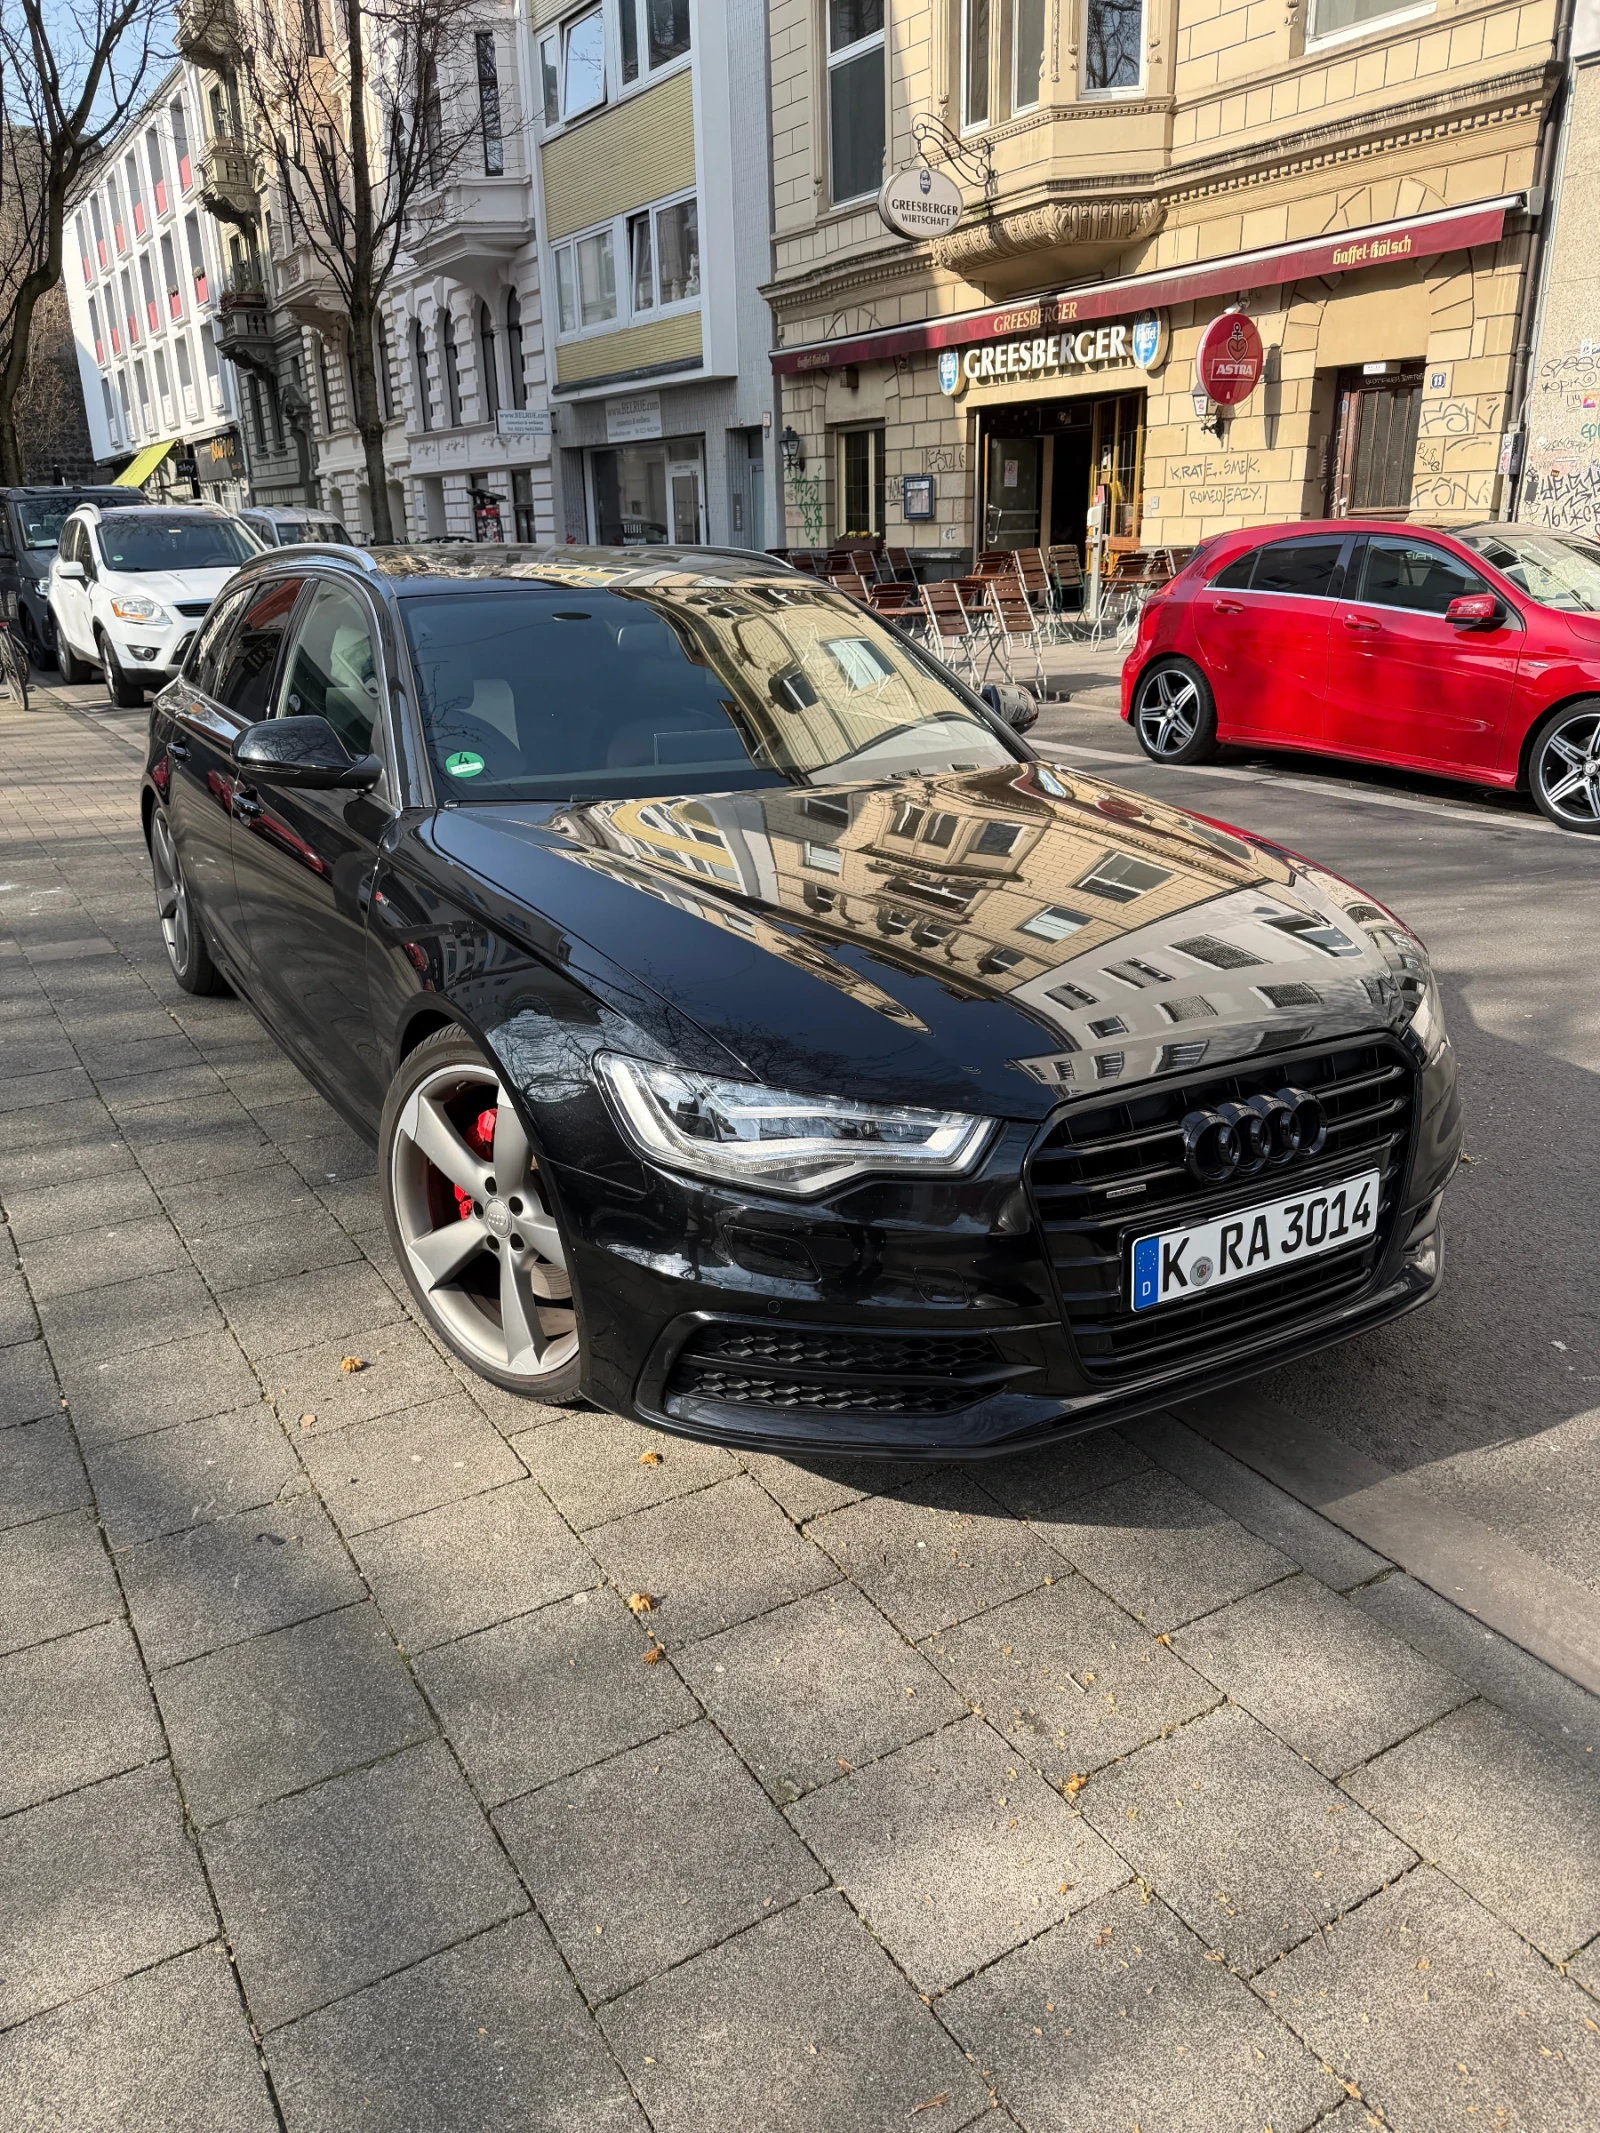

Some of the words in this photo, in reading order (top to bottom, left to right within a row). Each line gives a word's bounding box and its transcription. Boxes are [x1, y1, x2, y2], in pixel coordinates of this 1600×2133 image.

[892, 199, 959, 216] GREESBERGER
[901, 213, 950, 227] WIRTSCHAFT
[993, 301, 1077, 333] GREESBERGER
[963, 325, 1127, 379] GREESBERGER
[1215, 363, 1253, 376] ASTRA
[178, 461, 195, 473] sky
[458, 752, 470, 765] 4
[1161, 1236, 1190, 1293] K
[1219, 1214, 1271, 1275] RA
[1280, 1181, 1371, 1254] 3014
[1142, 1281, 1151, 1297] D
